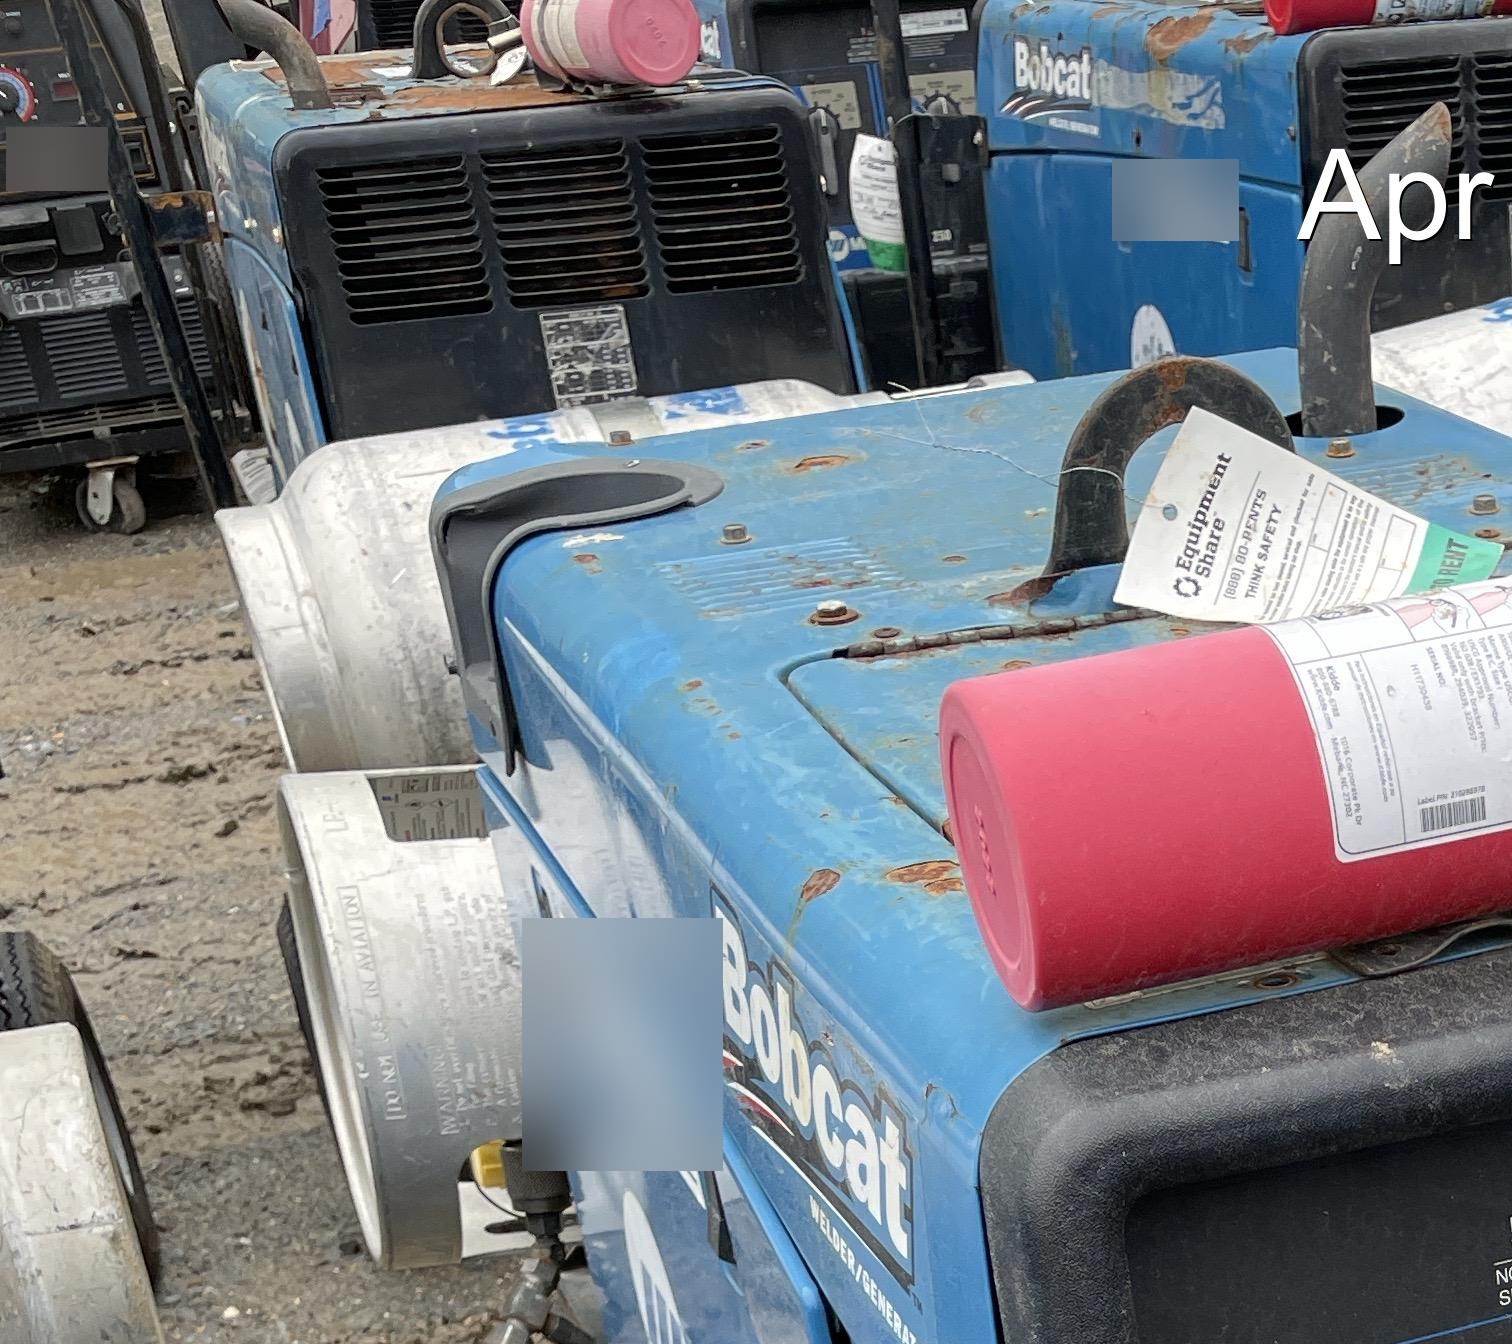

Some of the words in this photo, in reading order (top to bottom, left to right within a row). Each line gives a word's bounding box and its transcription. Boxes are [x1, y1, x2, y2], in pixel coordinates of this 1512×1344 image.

[1013, 36, 1092, 100] Bobcat
[1175, 453, 1232, 572] Equipment
[1197, 518, 1226, 578] Share
[1234, 488, 1267, 567] 80-RENTS
[1223, 564, 1246, 600] (888)
[1245, 554, 1264, 598] THINK
[1257, 503, 1284, 558] SAFETY
[1440, 537, 1469, 575] RENT
[714, 906, 912, 1262] Bobcat
